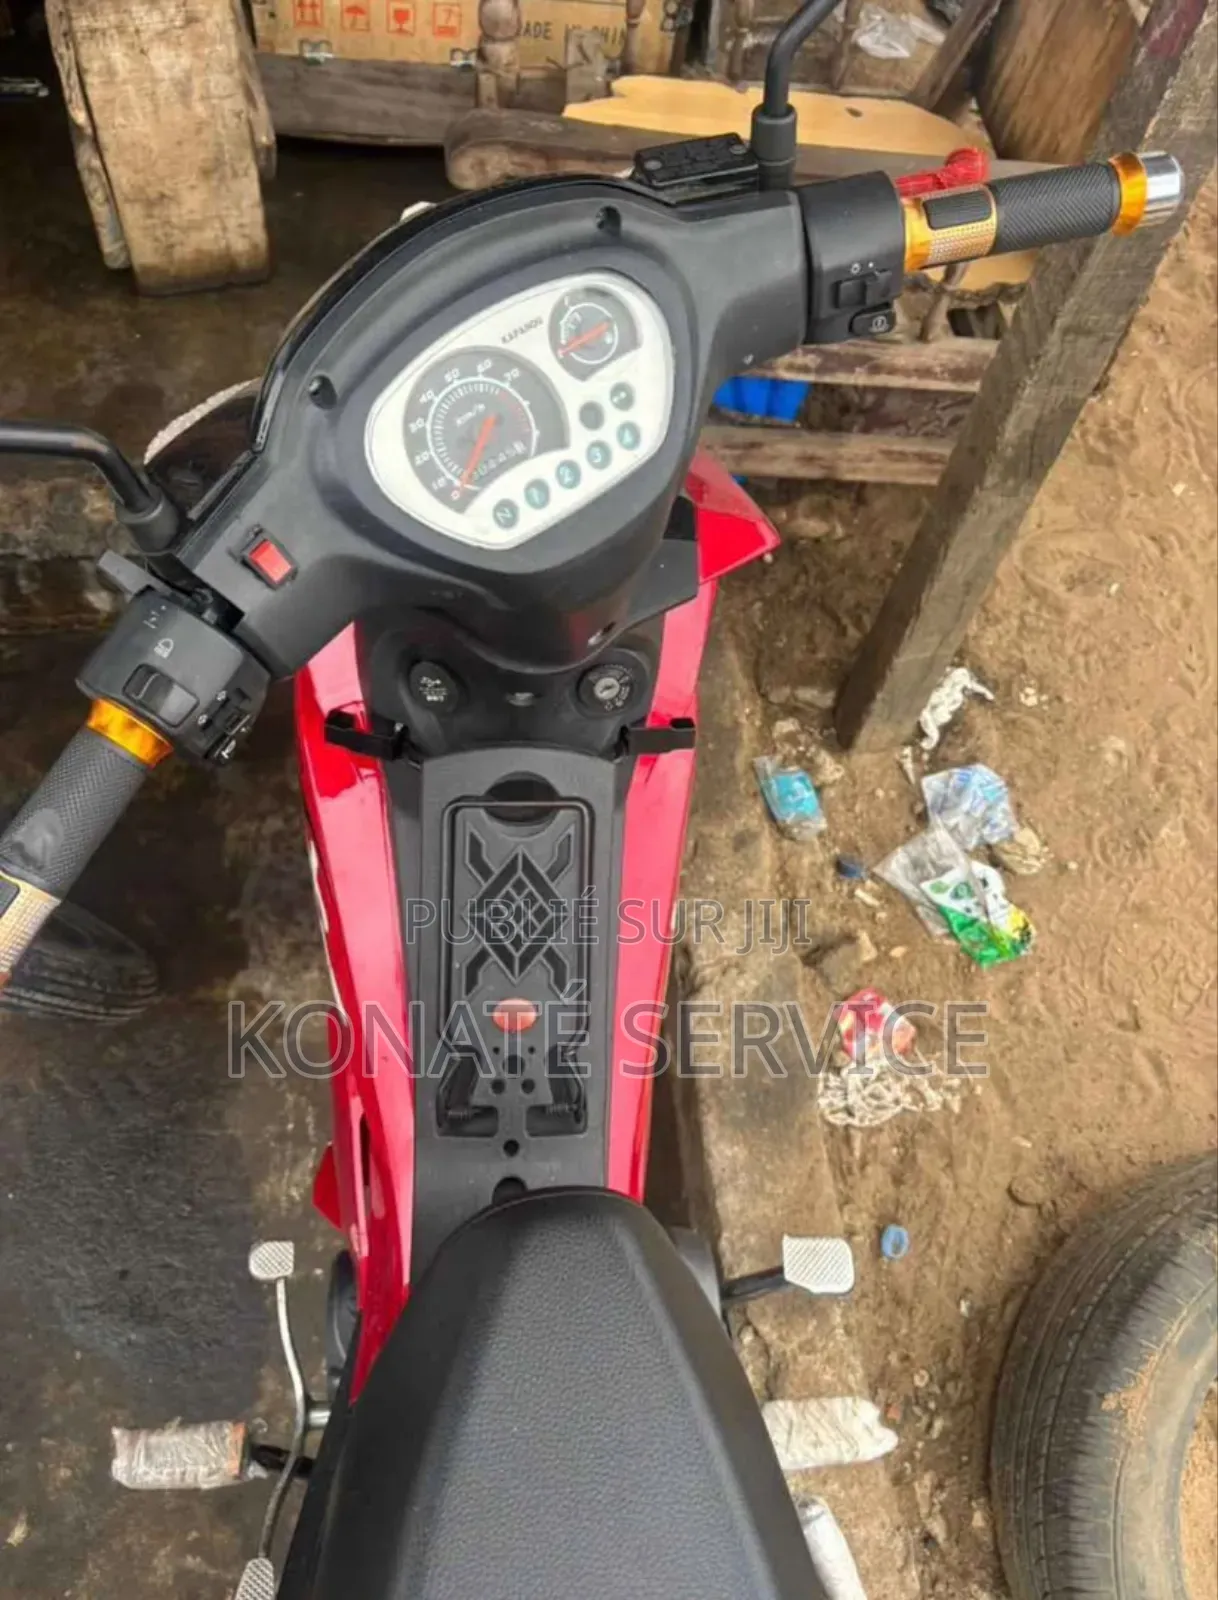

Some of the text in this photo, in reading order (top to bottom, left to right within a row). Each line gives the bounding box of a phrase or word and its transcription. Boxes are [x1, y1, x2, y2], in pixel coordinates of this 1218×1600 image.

[520, 21, 553, 40] ADE
[503, 368, 520, 382] 70
[419, 389, 435, 404] 40
[414, 451, 430, 466] 20
[432, 476, 447, 491] 10
